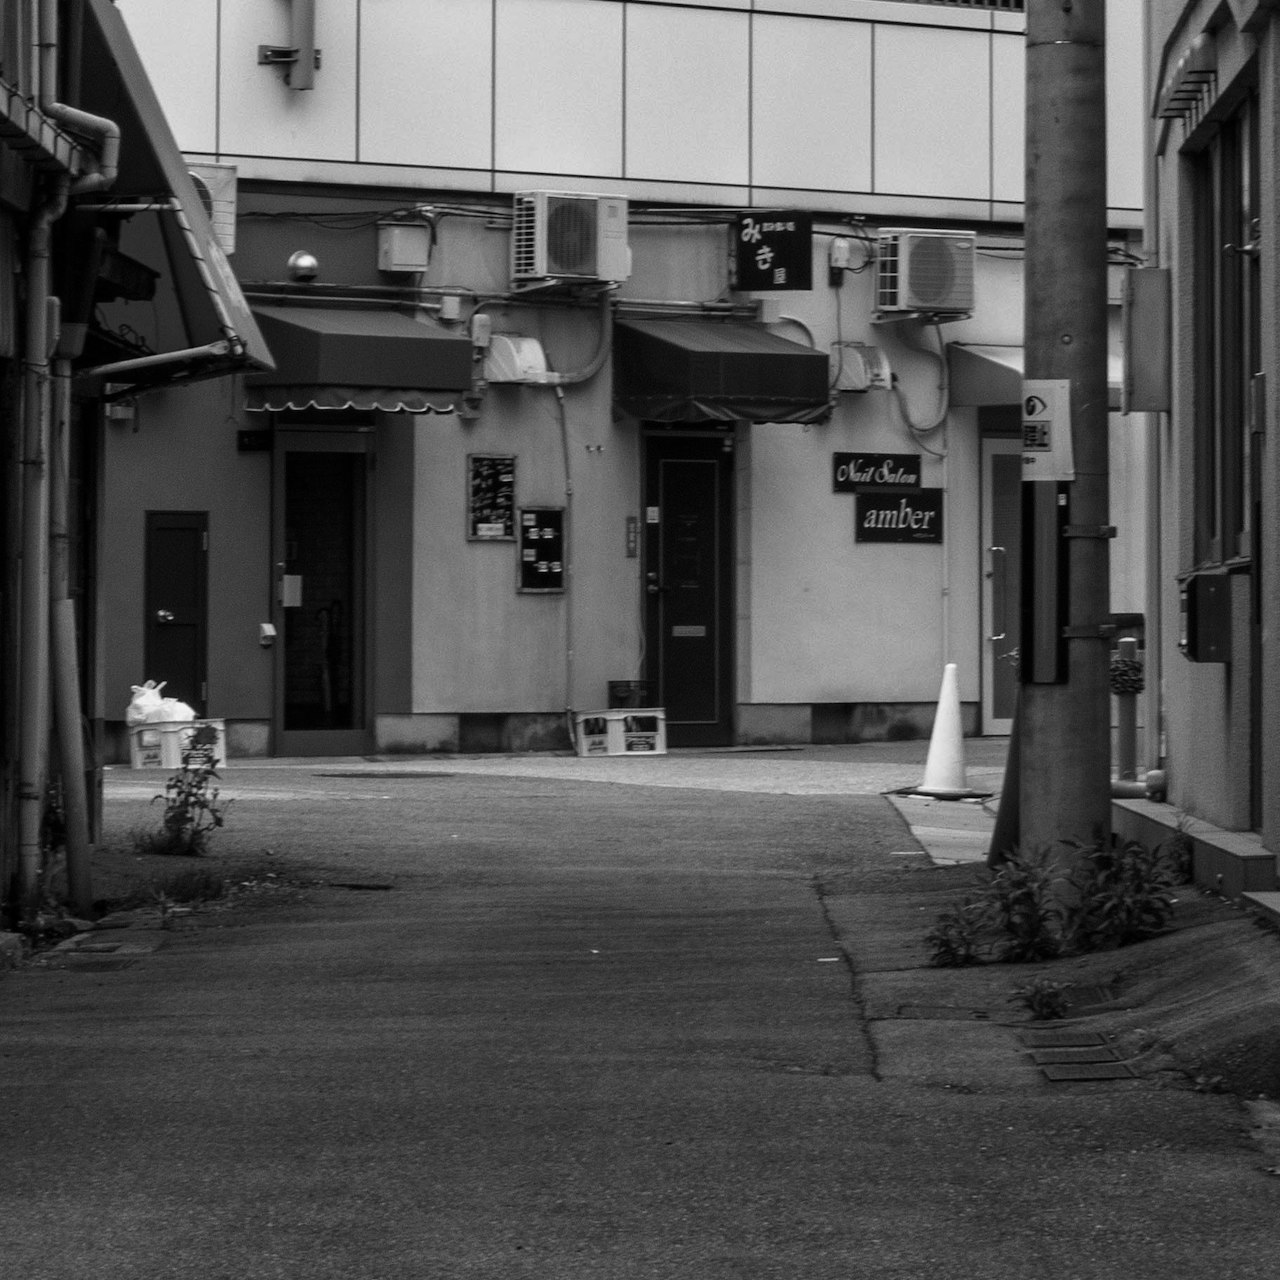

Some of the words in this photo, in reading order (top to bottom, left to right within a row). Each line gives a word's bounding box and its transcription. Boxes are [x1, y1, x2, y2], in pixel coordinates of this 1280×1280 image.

[836, 459, 875, 483] Nail
[874, 459, 918, 484] Salon
[863, 498, 936, 529] amber
